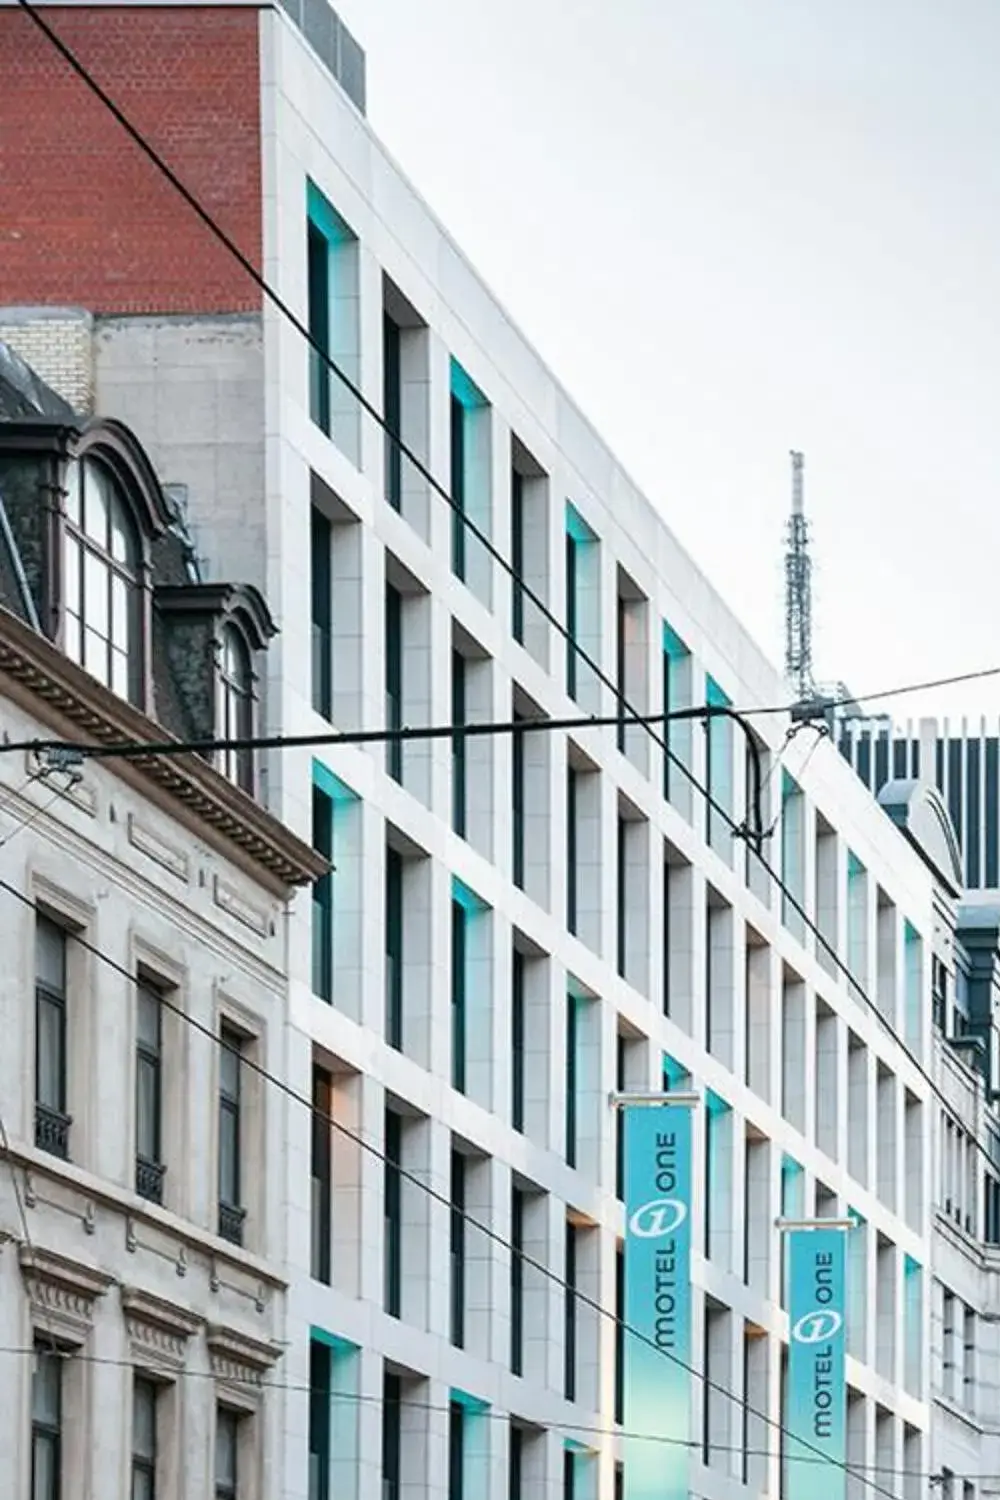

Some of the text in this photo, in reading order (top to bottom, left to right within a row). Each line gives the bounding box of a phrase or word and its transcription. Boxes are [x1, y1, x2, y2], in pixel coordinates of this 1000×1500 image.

[655, 1132, 677, 1193] ONE
[654, 1239, 676, 1349] MOTEL
[814, 1252, 834, 1304] ONE
[813, 1344, 833, 1438] MOTEL
